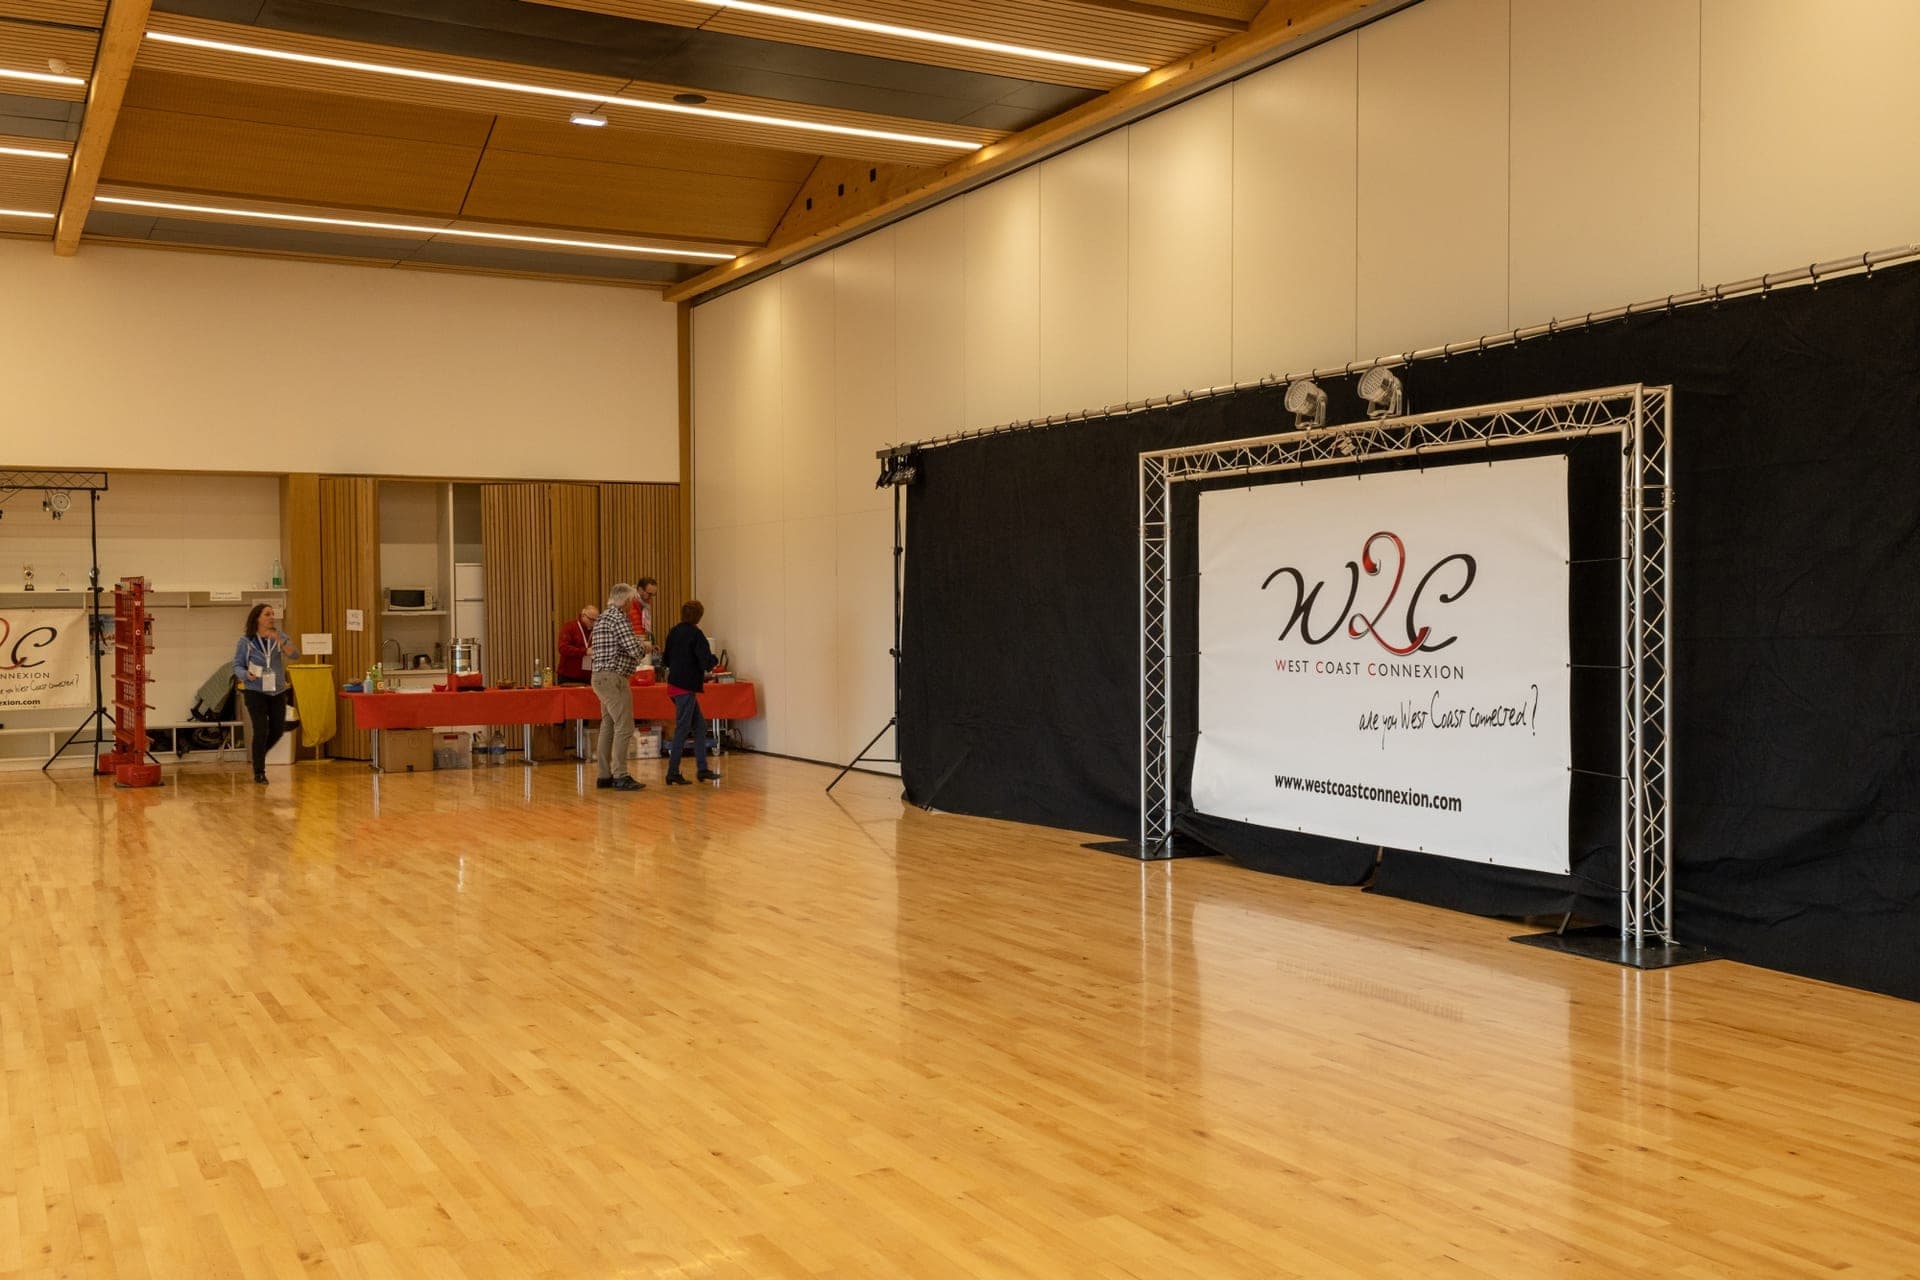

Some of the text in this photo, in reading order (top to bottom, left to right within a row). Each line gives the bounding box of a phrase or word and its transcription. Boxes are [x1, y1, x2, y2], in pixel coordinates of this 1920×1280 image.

[1261, 531, 1477, 656] W2C
[1275, 660, 1464, 680] WEST COAST CONNEXION
[1400, 699, 1428, 730] West
[1430, 690, 1466, 729] Coast
[1274, 774, 1462, 812] www.westcoastconnexion.com
